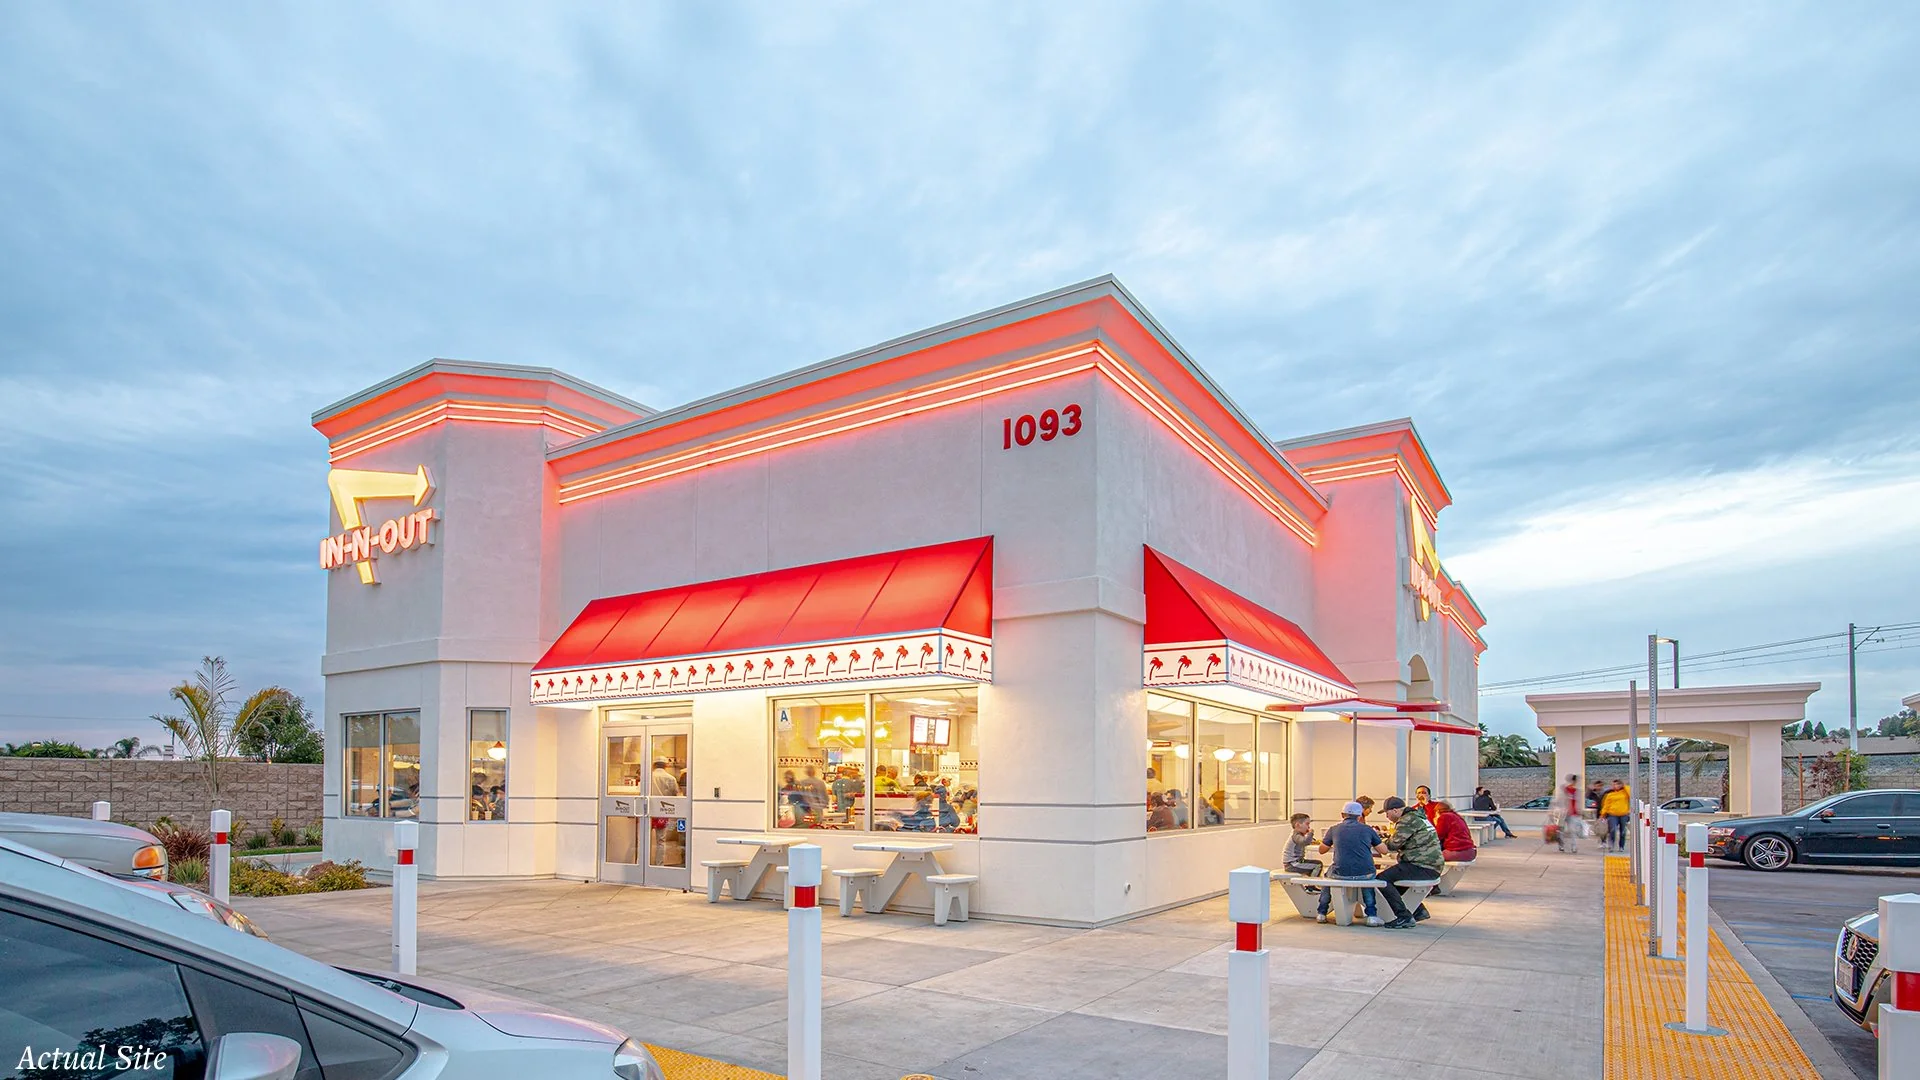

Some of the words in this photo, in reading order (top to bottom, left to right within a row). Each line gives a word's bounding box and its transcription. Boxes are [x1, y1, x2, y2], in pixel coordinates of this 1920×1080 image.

[1003, 403, 1083, 450] 1093
[320, 508, 433, 569] IN-N-OUT
[780, 710, 789, 722] A
